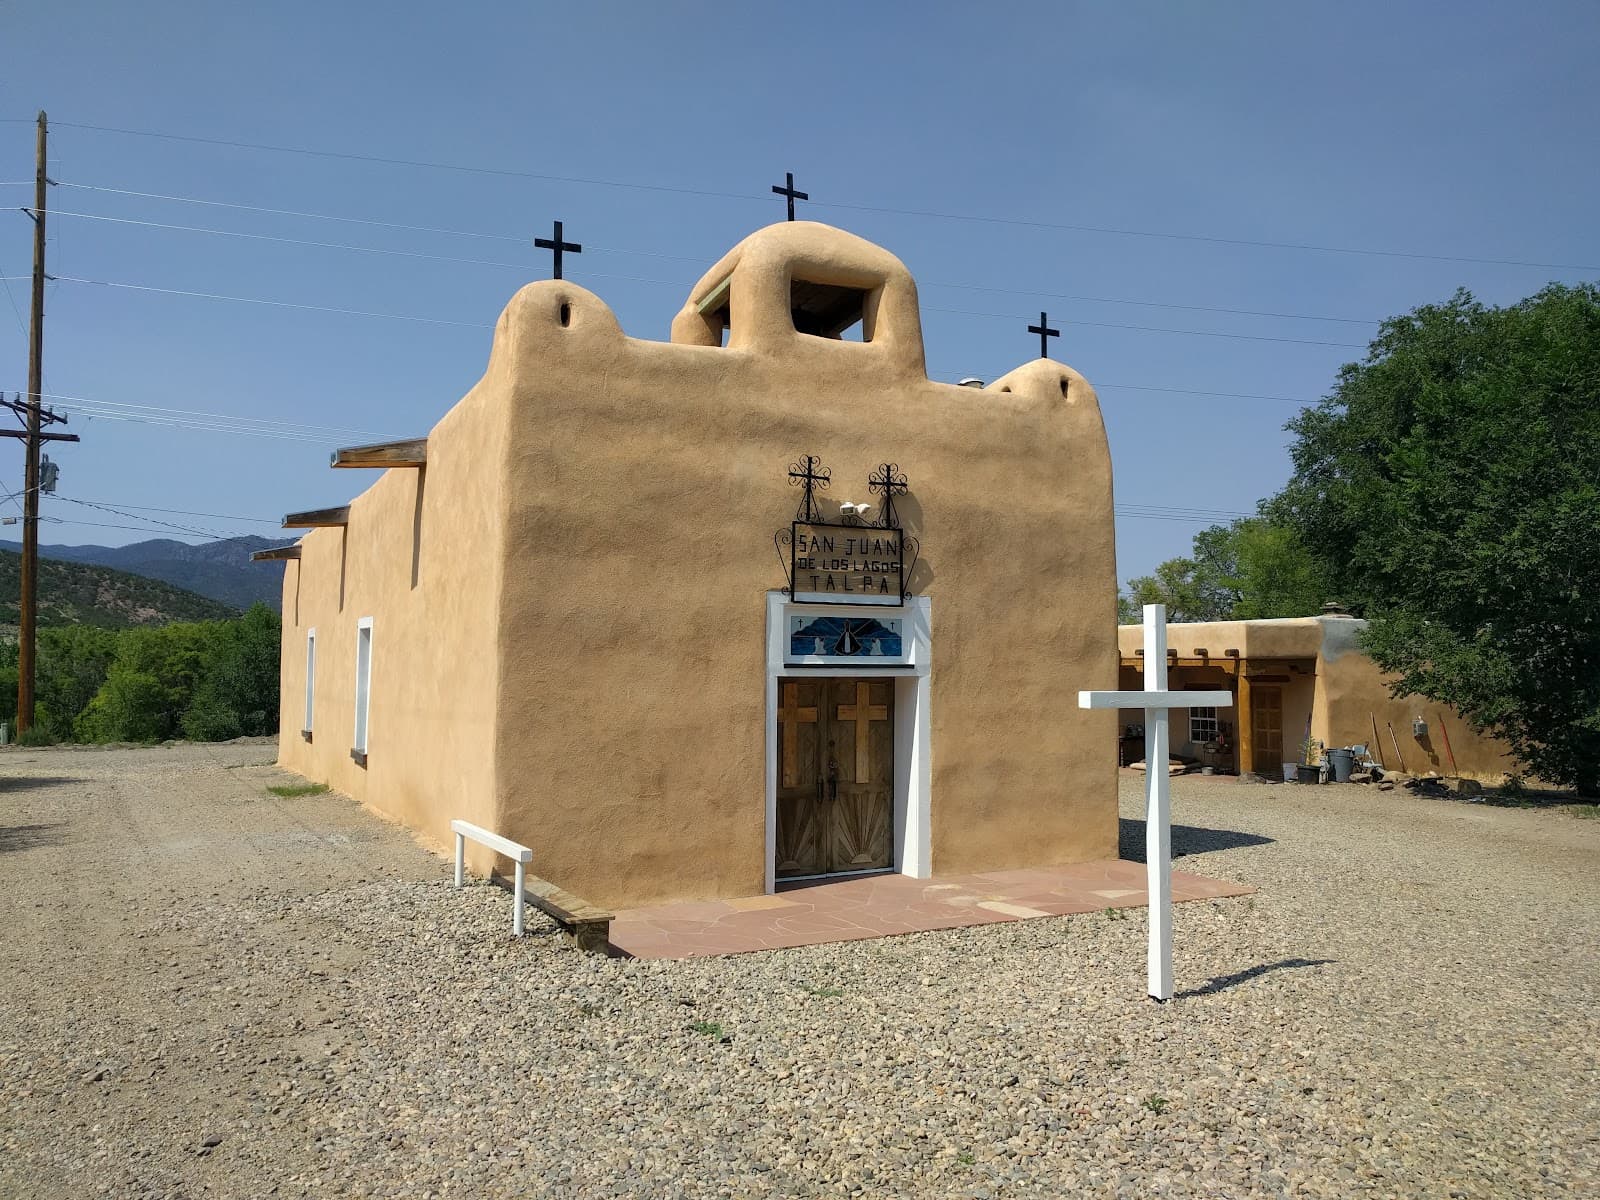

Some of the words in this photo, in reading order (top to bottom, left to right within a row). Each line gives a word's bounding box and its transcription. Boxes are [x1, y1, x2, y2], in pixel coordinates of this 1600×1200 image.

[799, 535, 834, 553] SAN
[846, 538, 897, 556] JUAN
[798, 557, 815, 570] DE
[823, 558, 848, 570] LOS
[854, 559, 899, 573] LAGOS
[810, 574, 888, 594] TALPA
